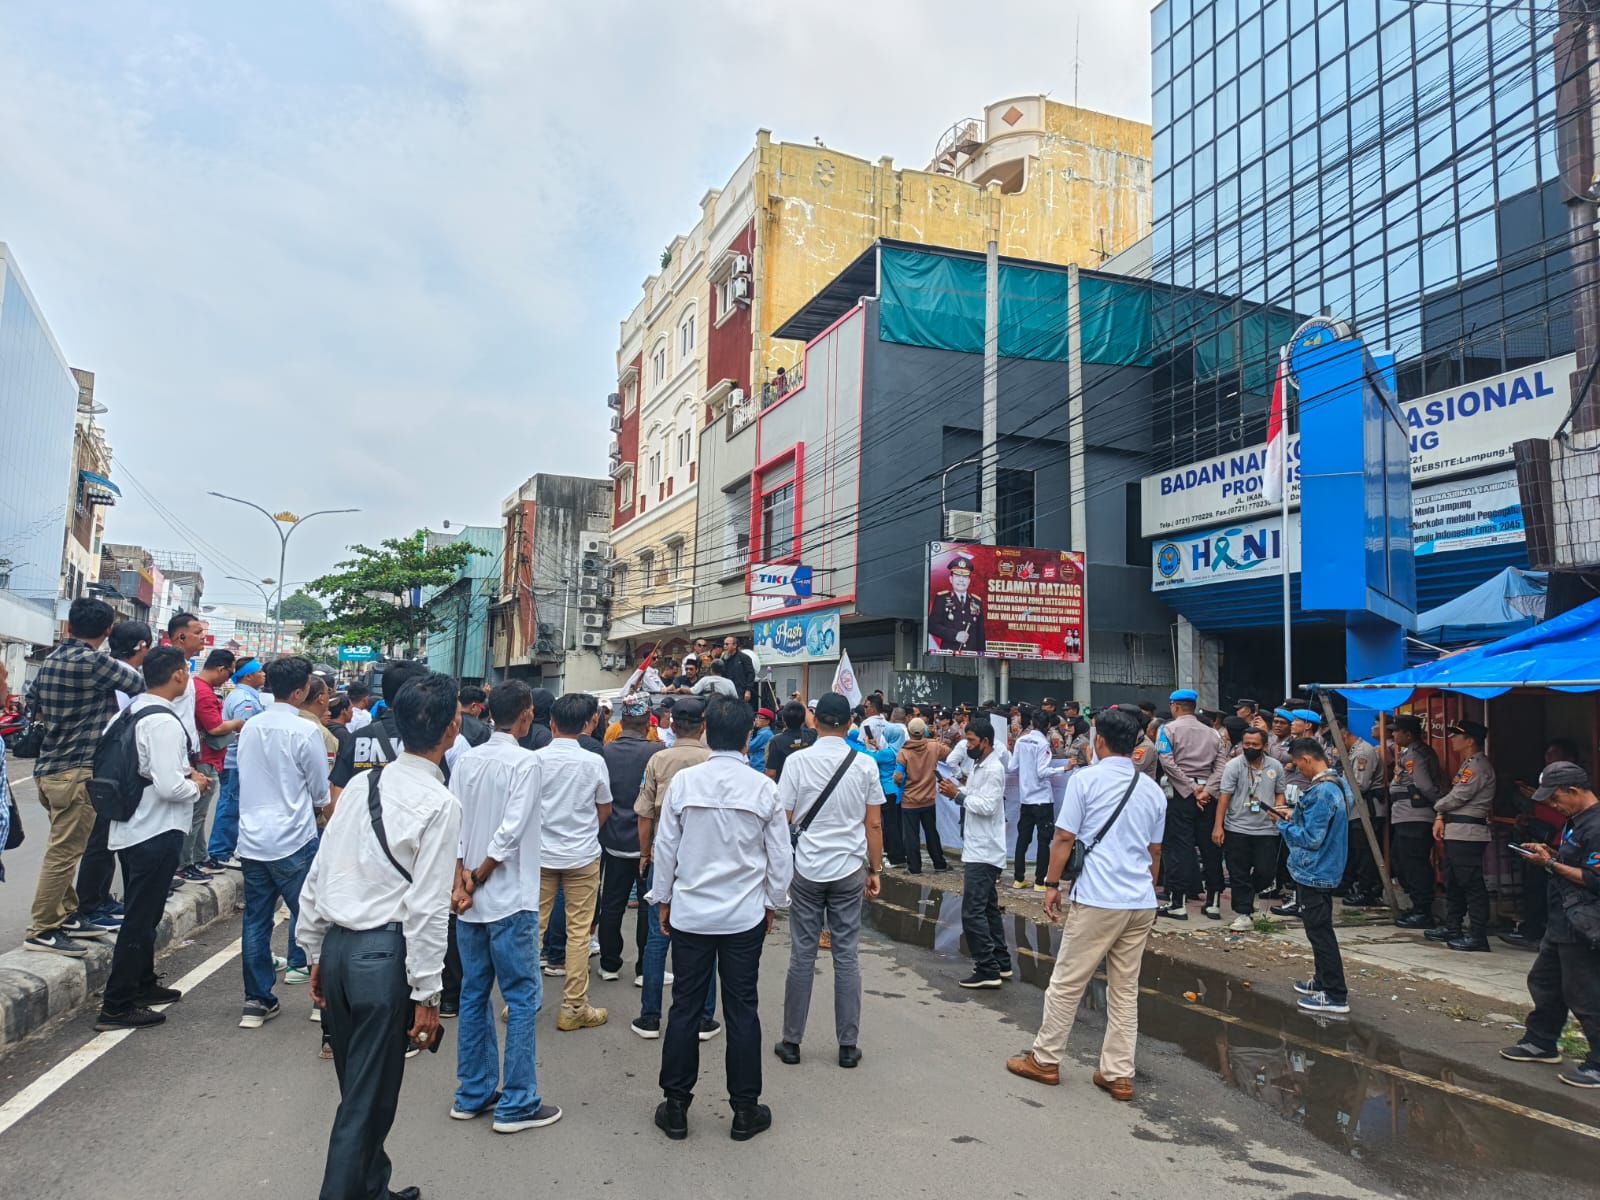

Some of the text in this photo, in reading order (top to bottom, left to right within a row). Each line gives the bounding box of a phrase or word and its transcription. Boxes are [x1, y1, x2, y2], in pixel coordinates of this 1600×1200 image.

[1160, 461, 1225, 496] BADAN
[1436, 499, 1472, 513] Lampung
[1435, 526, 1473, 541] Indonesia
[1475, 524, 1498, 535] Emas
[1500, 519, 1521, 532] 2045
[760, 574, 787, 584] TIKI
[988, 579, 1080, 597] SELAMAT DATANG
[997, 595, 1027, 604] KAWASAN
[1045, 597, 1080, 606] INTEGRITAS
